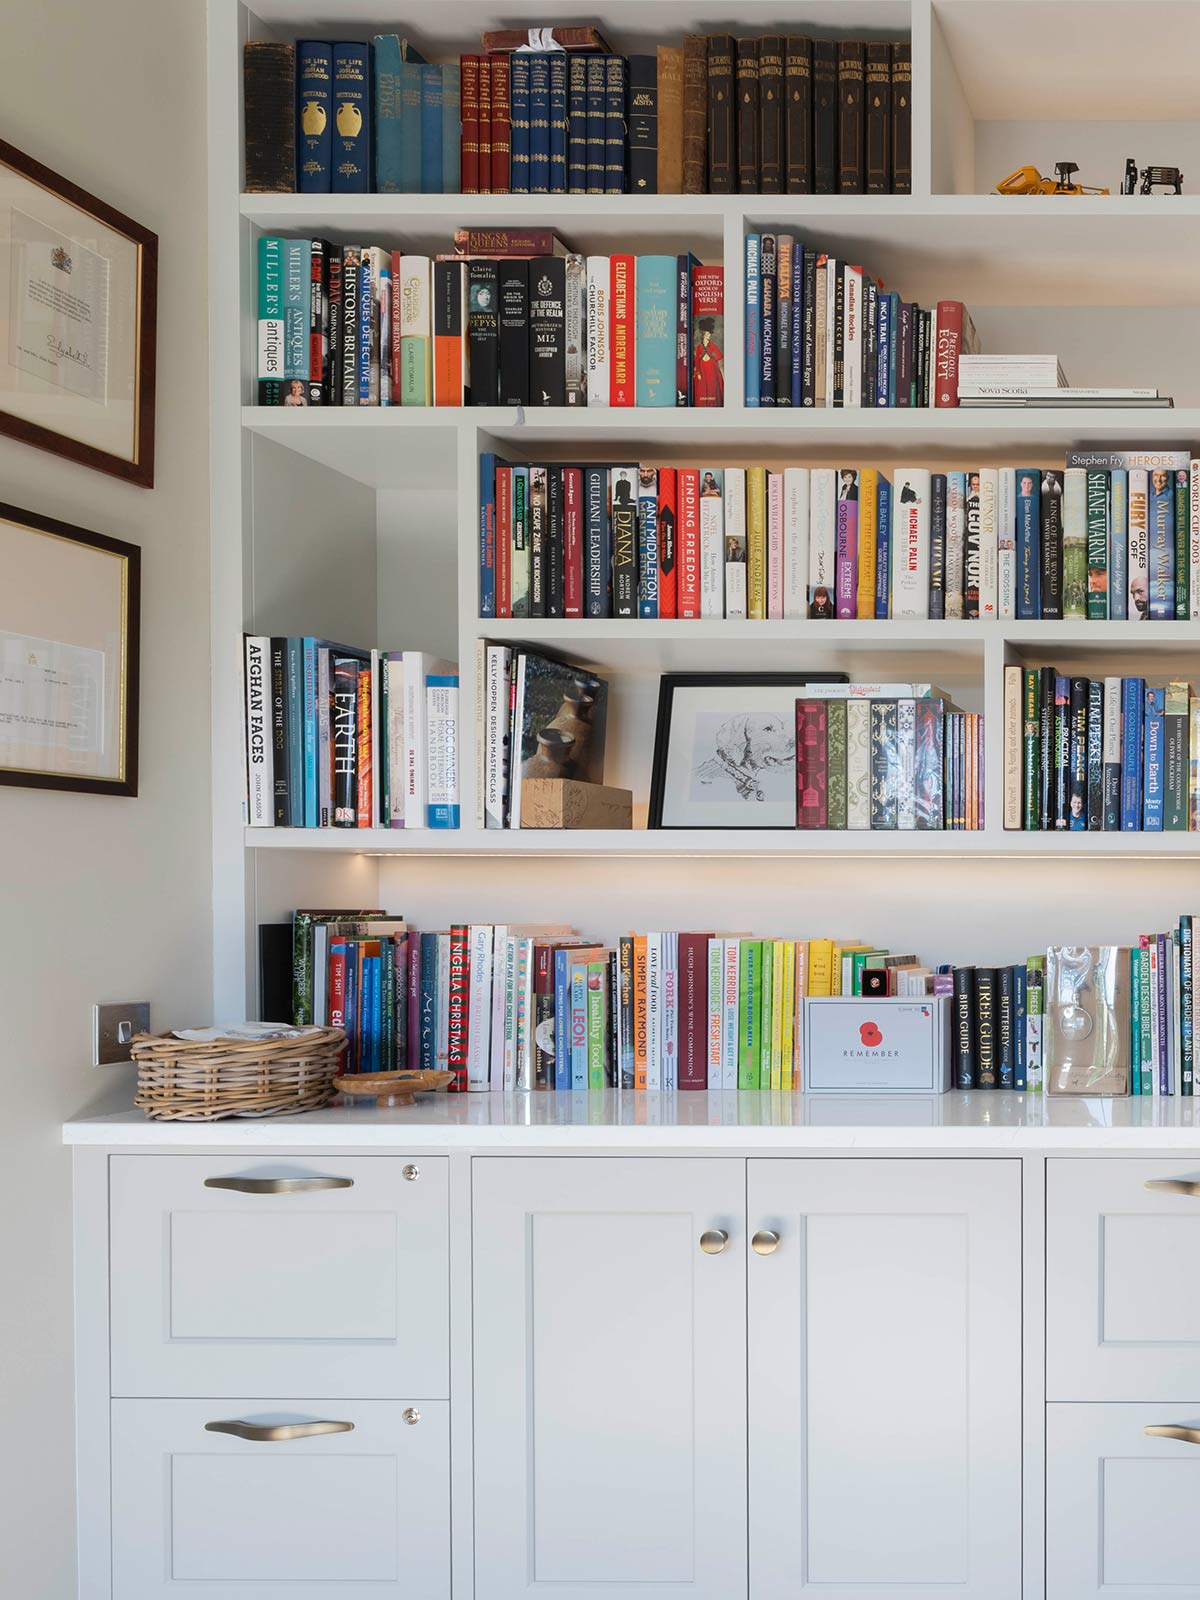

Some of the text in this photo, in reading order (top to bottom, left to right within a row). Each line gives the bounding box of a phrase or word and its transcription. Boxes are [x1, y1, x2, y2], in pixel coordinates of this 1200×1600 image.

[266, 240, 281, 372] MILLER'S antiques
[289, 247, 305, 366] MILLER'S ANTIQUES
[344, 267, 356, 326] HISTORY
[747, 240, 757, 304] MICHAEL PALIN
[780, 244, 790, 298] HIMALAYA
[848, 279, 856, 312] Canadian
[361, 268, 370, 382] ANTIQUES DETECTIVE
[615, 262, 627, 384] ELIZABETHANS ANDREW MARR
[763, 278, 772, 381] SAHARA MICHAEL PALIN
[938, 329, 949, 380] EGYPT
[948, 332, 958, 378] PRECIOUS
[344, 336, 356, 390] BRITAIN
[1072, 456, 1174, 467] Stephen Fry HEROES
[589, 474, 600, 595] GIULIANI LEADERSHIP
[617, 512, 632, 566] DIANA
[686, 475, 695, 592] FINDING FREEDOM
[909, 508, 918, 571] MICHAEL PALIN
[1050, 526, 1057, 539] OF
[1088, 474, 1105, 564] SHANE WARNE
[1130, 493, 1146, 529] FURY
[646, 501, 656, 600] ANT MIDDLETON
[1130, 541, 1138, 559] OFF
[1152, 501, 1170, 600] Murray Walker
[250, 644, 263, 763] AFGHAN FACES
[335, 693, 356, 775] EARTH
[1149, 721, 1159, 793] Down to Earth
[476, 932, 486, 983] Gary Rhodes
[727, 946, 736, 1005] TOM KERRIDGE
[451, 943, 462, 1061] NIGELLA CHRISTMAS
[573, 1008, 584, 1047] LEON
[637, 955, 646, 1057] SIMPLY RAYMOND
[711, 948, 720, 1066] TOM KERRIDGE'S FRESH START
[959, 994, 969, 1054] BIRD GUIDE
[979, 983, 992, 1070] TREE GUIDE
[1140, 952, 1150, 1039] GARDEN DESIGN BIBLE
[590, 996, 601, 1068] healthy food
